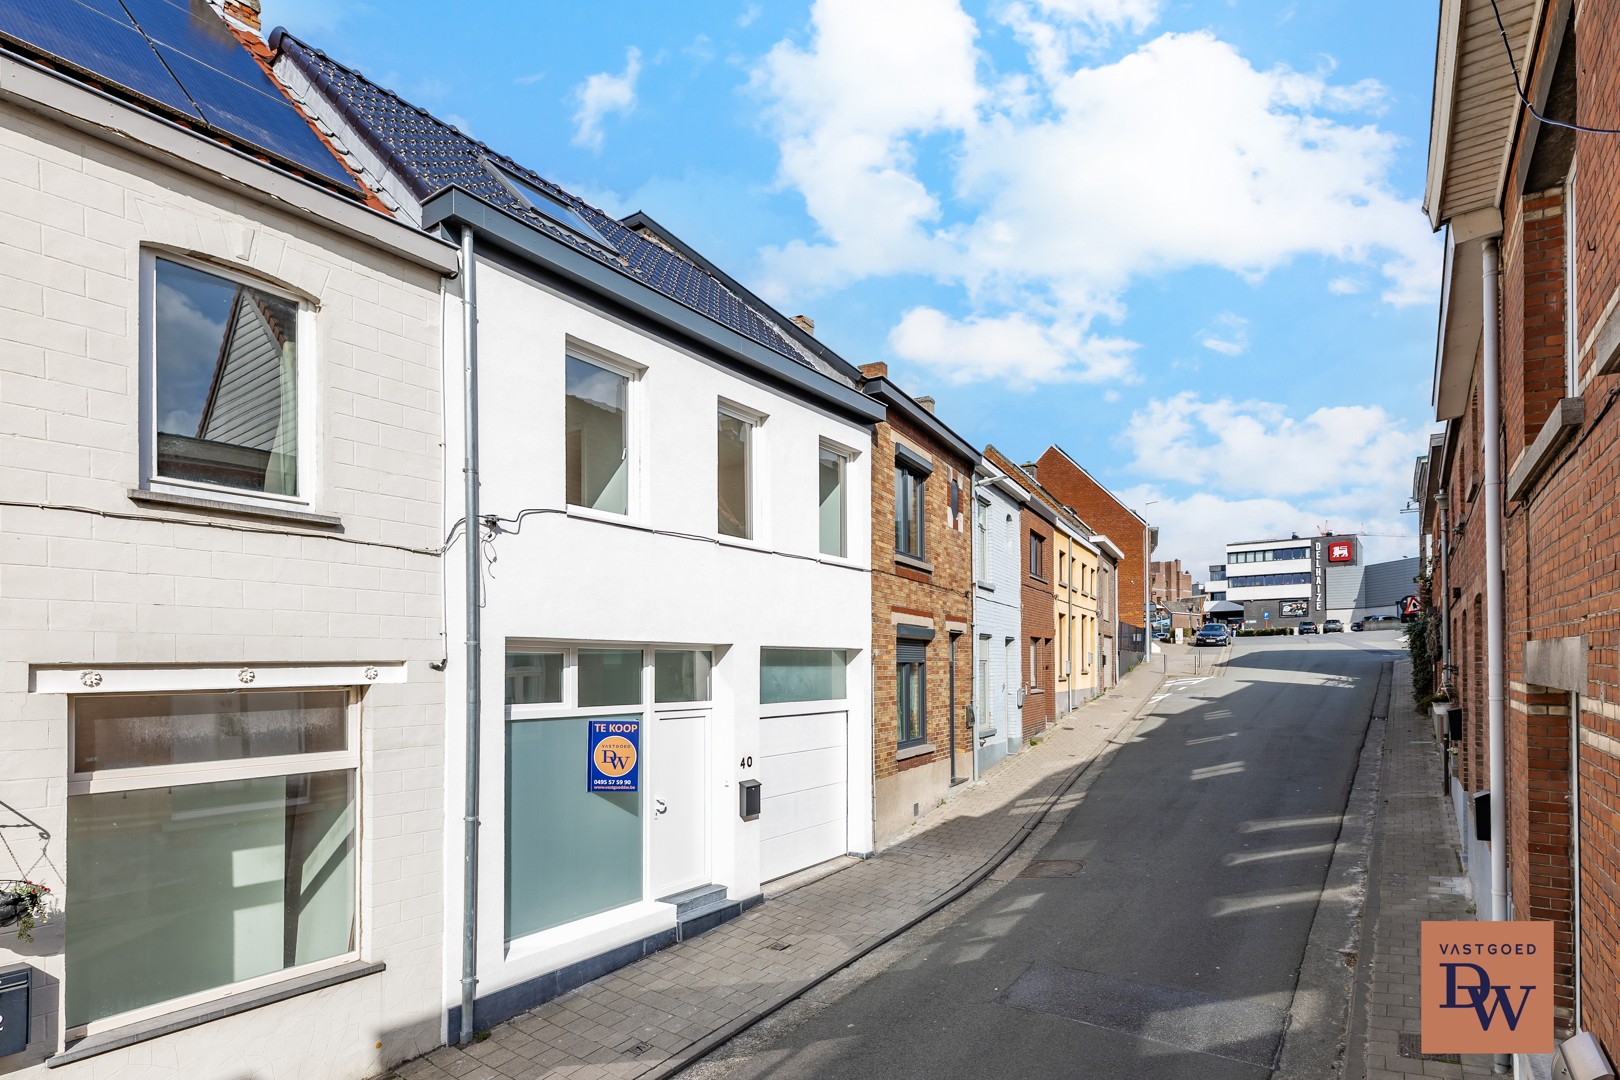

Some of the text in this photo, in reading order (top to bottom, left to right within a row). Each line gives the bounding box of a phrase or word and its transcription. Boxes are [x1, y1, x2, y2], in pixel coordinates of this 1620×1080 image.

[594, 723, 638, 733] TE KOOP
[601, 749, 631, 770] DW
[740, 756, 753, 769] 40
